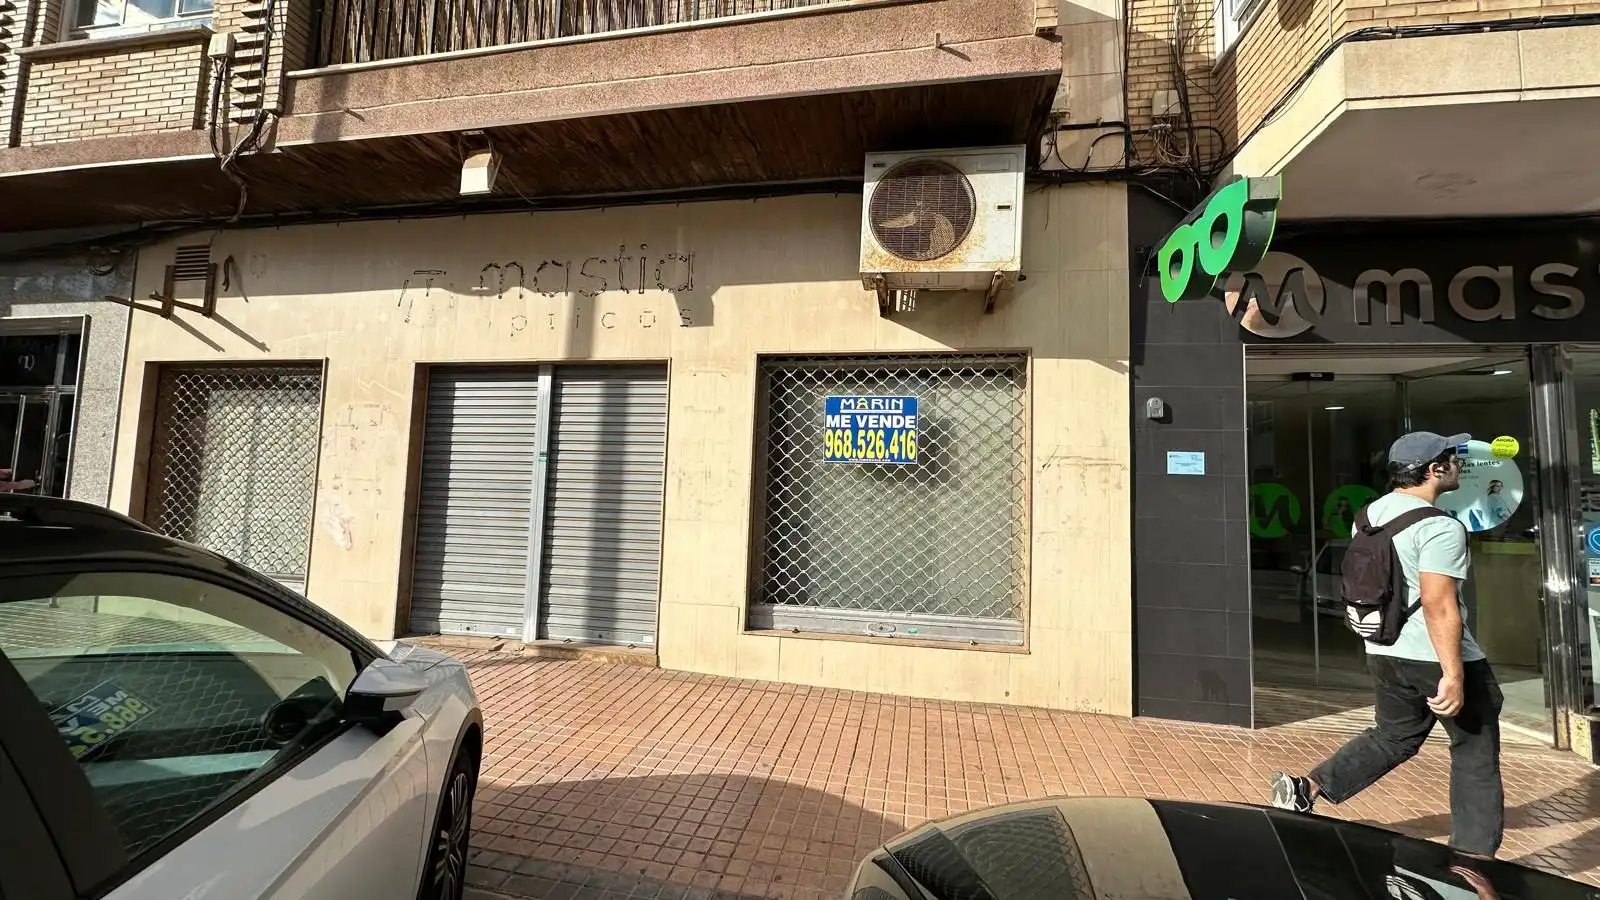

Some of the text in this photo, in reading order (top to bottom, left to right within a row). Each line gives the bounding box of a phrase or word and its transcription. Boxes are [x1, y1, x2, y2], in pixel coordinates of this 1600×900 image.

[480, 244, 695, 300] mastia
[826, 415, 916, 429] ME VENDE
[825, 429, 916, 460] 968.526.416
